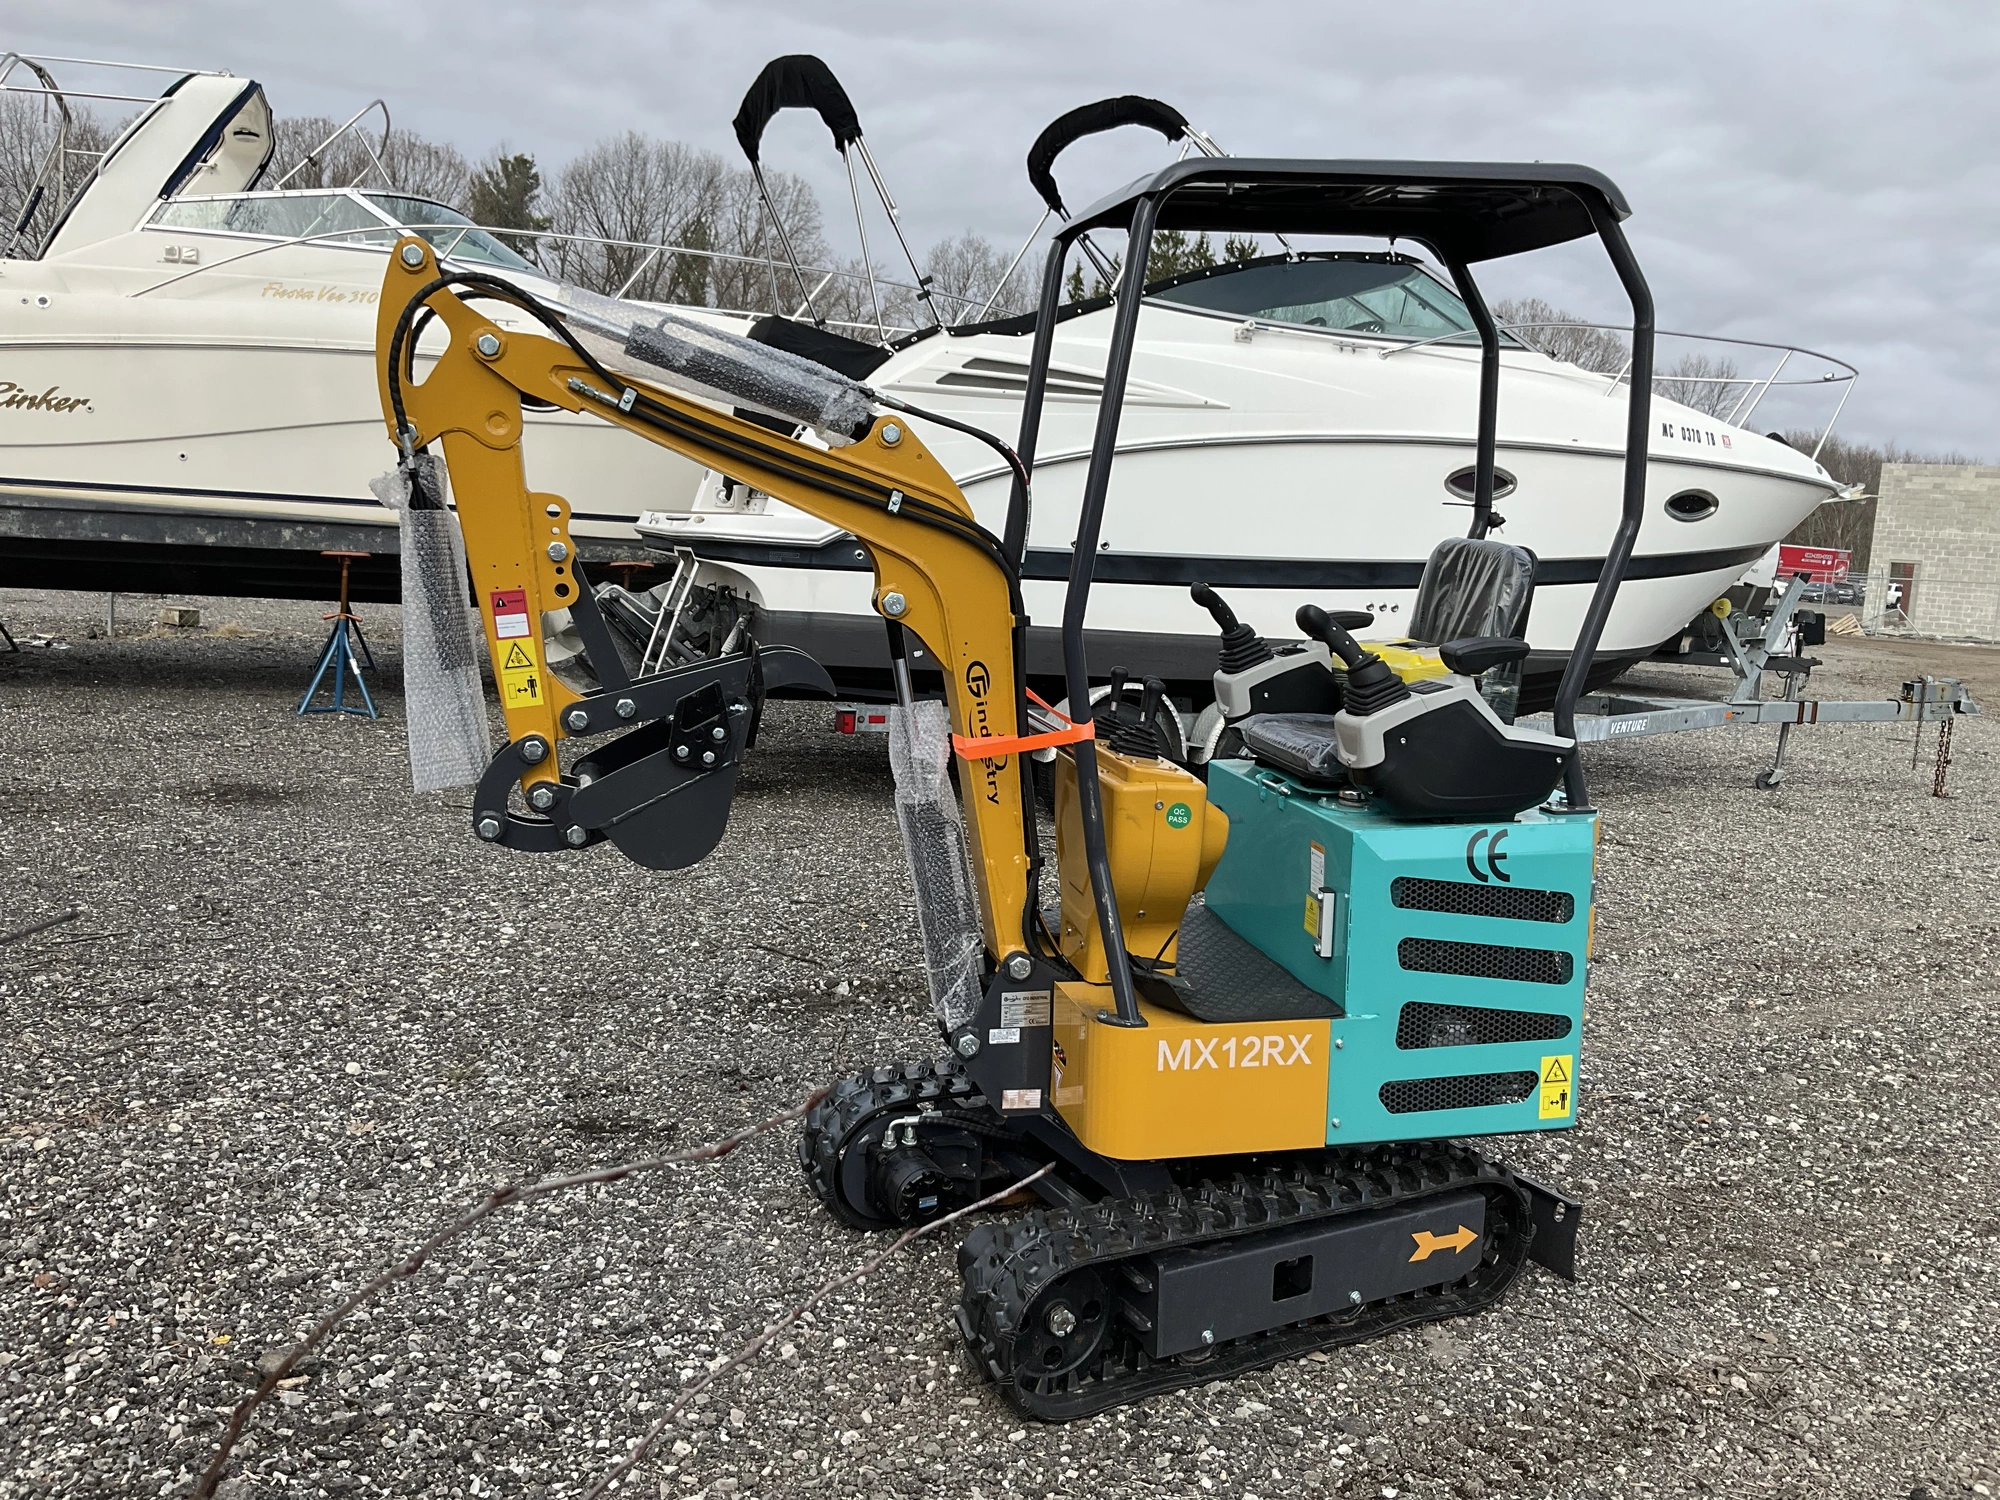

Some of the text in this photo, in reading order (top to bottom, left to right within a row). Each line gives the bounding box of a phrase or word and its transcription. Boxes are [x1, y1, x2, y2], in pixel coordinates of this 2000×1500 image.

[261, 281, 380, 304] Fiesta Vee 310
[1661, 422, 1674, 439] MC
[1680, 426, 1702, 444] 0370
[1610, 718, 1648, 735] VENTURE
[1168, 815, 1188, 824] PASS
[1173, 807, 1186, 816] QC
[1466, 828, 1511, 883] CE
[1157, 1033, 1313, 1072] MX12RX
